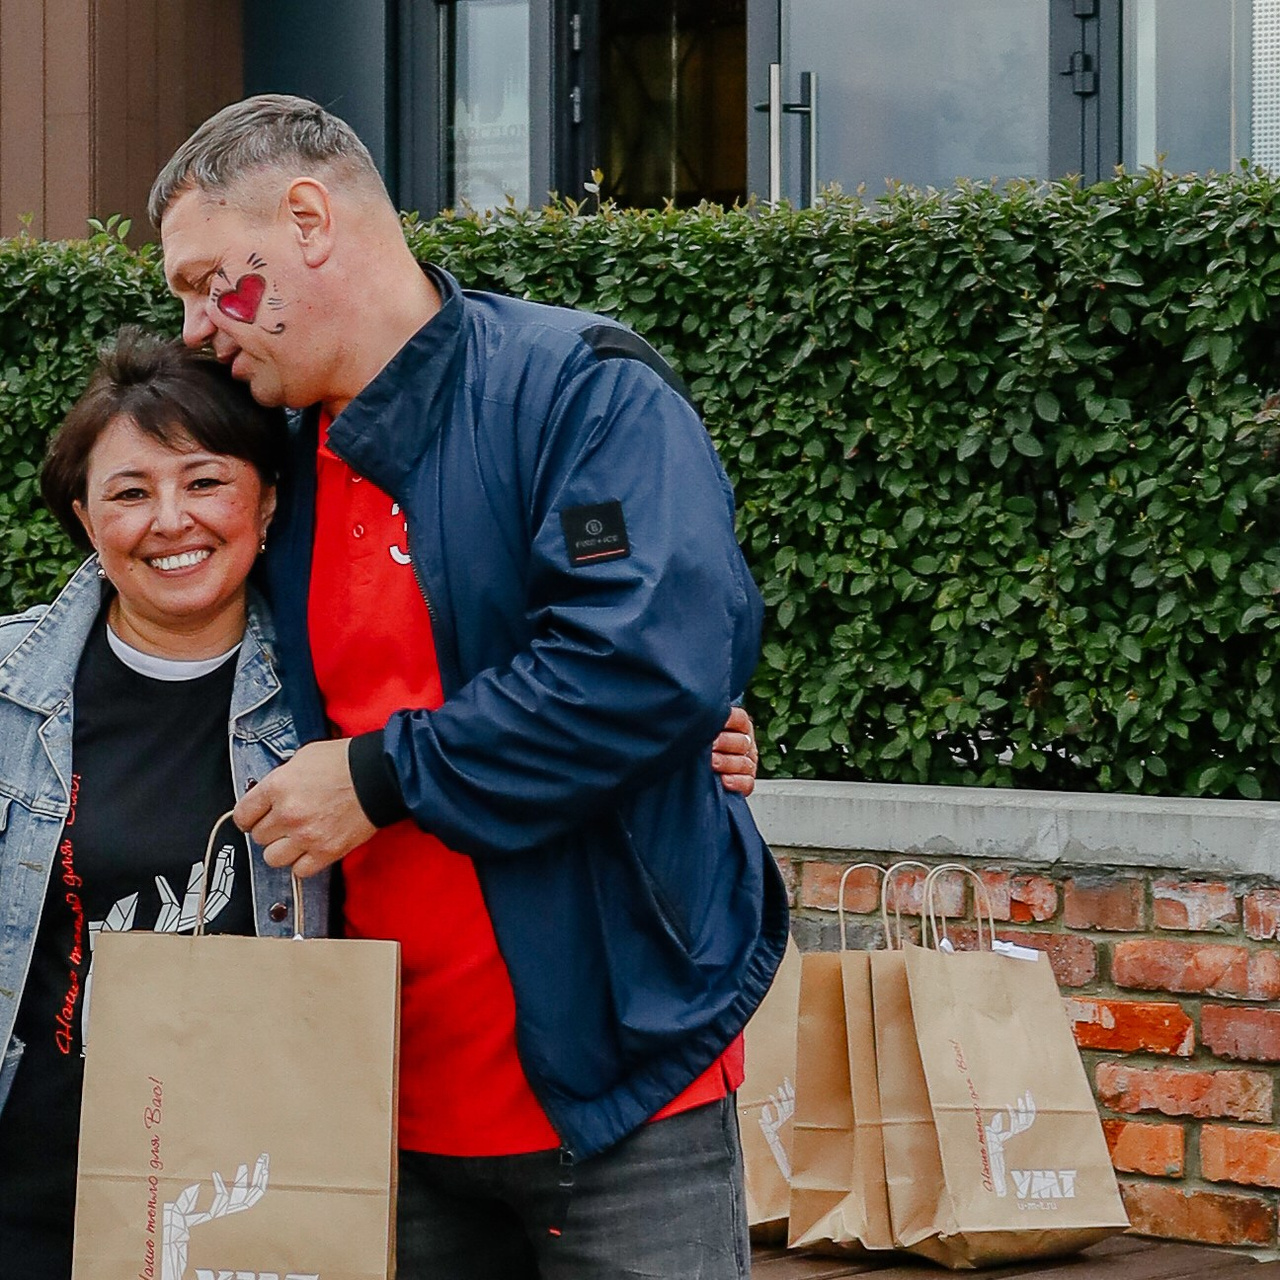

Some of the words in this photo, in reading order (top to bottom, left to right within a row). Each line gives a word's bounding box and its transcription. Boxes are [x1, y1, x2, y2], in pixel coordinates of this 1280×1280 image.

[60, 839, 82, 887] для
[144, 1076, 164, 1129] Вас!
[150, 1134, 164, 1171] для
[146, 1175, 159, 1233] тепло
